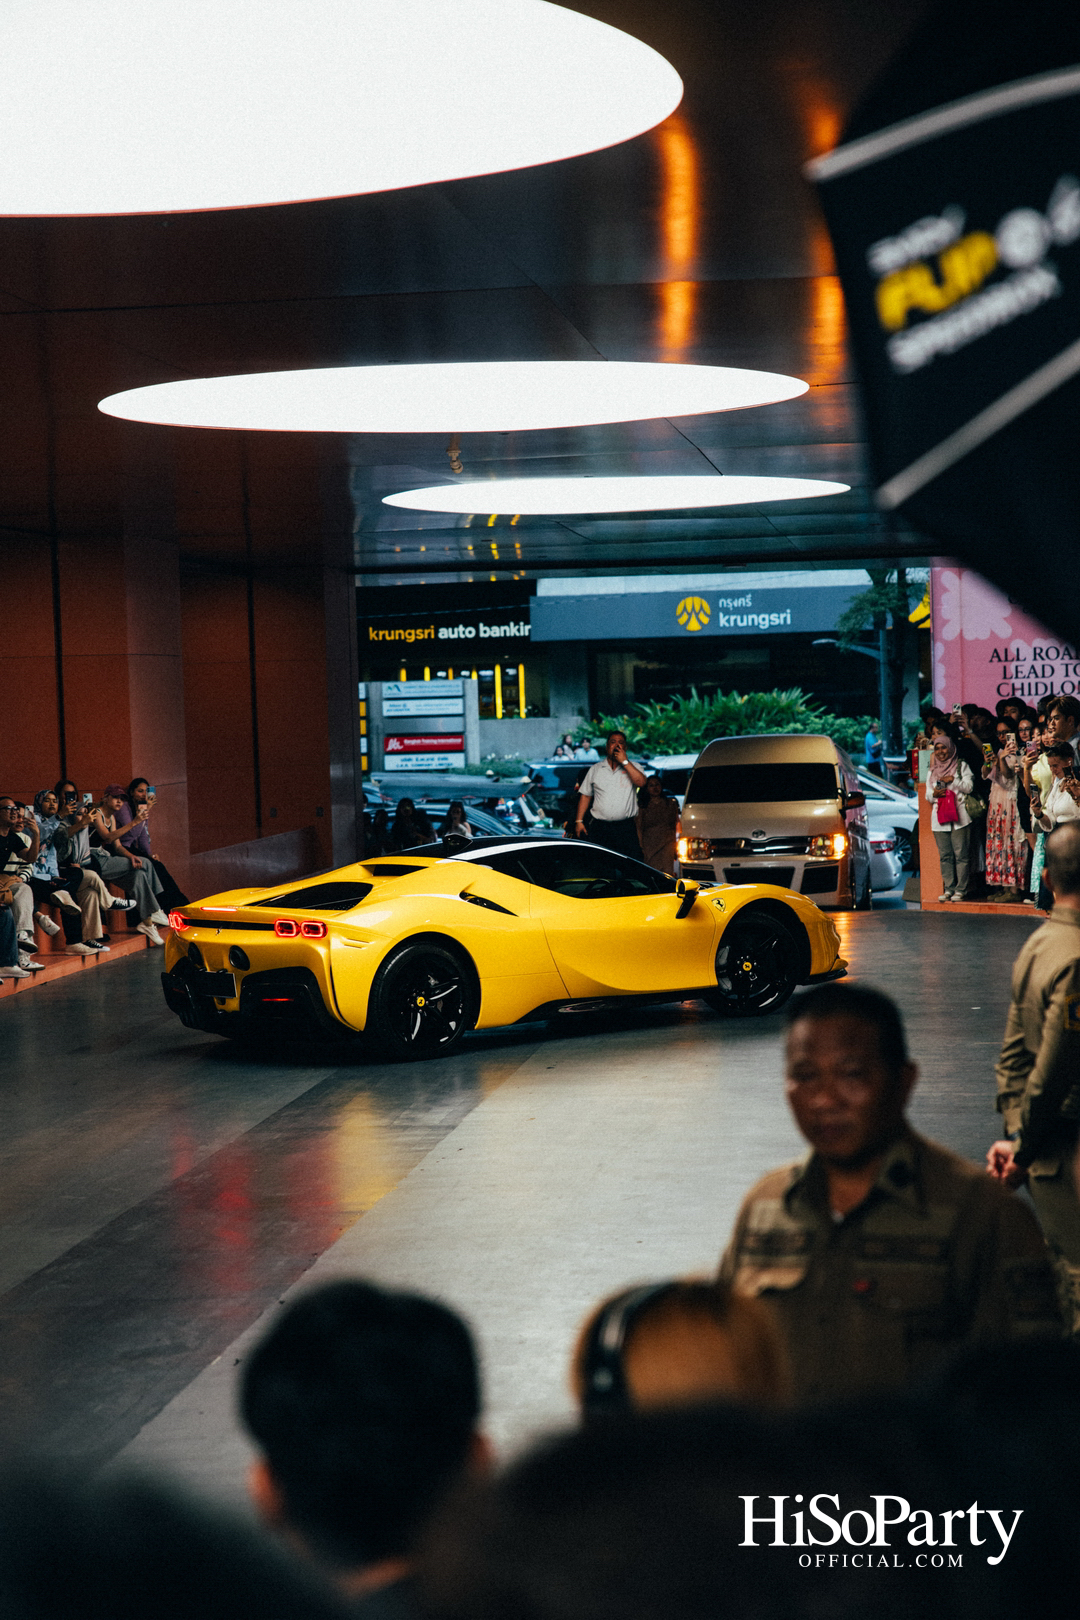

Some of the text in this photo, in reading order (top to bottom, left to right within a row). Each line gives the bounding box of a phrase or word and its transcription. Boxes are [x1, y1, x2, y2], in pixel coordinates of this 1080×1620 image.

[718, 593, 752, 611] กรุงศรี
[719, 609, 791, 629] krungsri
[369, 625, 435, 643] krungsri
[438, 624, 476, 639] auto
[989, 646, 1080, 663] ALL ROA
[1002, 664, 1055, 679] LEAD
[996, 680, 1080, 697] CHIDLO
